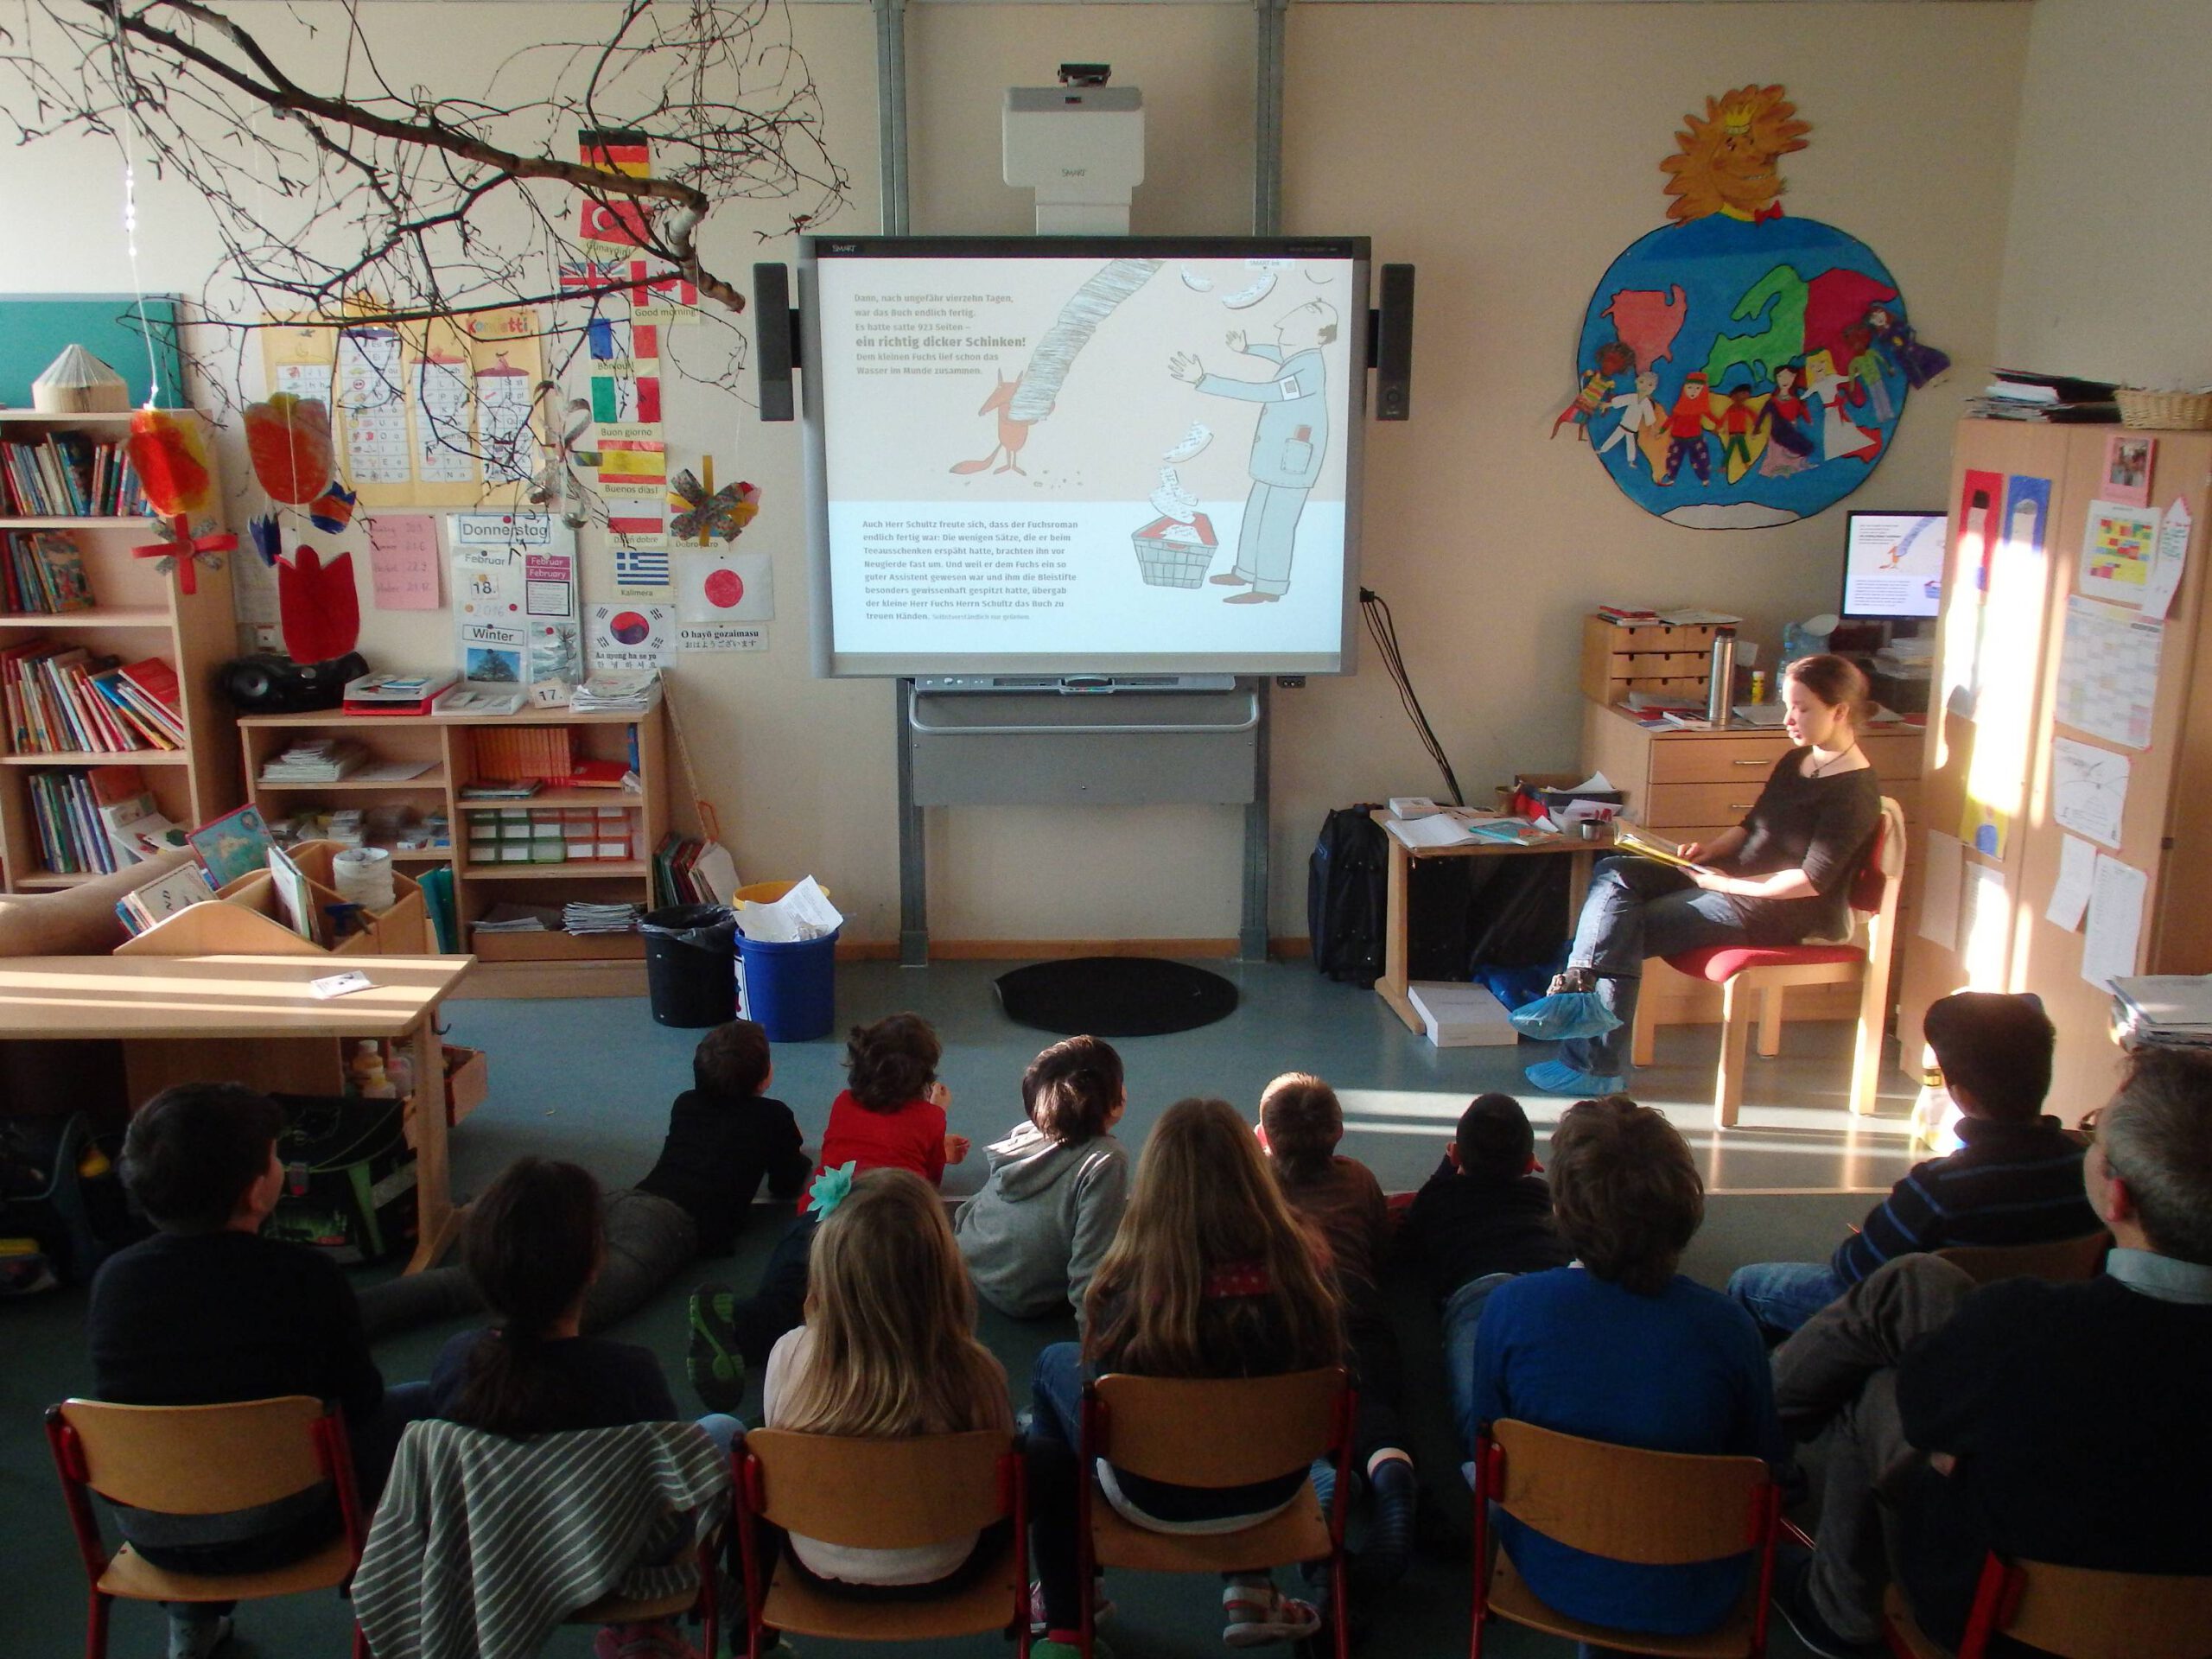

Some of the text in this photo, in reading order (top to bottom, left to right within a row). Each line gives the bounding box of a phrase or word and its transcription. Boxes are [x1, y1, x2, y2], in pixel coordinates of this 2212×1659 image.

[832, 244, 857, 252] SMART
[855, 294, 1014, 303] Dann, nach ungefähr vierzehn Tagen,
[660, 308, 699, 318] morning!
[873, 308, 889, 317] das
[891, 308, 912, 317] Buch
[914, 308, 946, 317] endlich
[949, 308, 976, 318] fertig.
[855, 336, 1026, 349] ein richtig dicker Schinken!
[877, 353, 910, 361] kleinen
[912, 353, 937, 361] Fuchs
[938, 353, 954, 361] lief
[955, 353, 981, 361] schon
[983, 353, 999, 361] das
[890, 366, 901, 375] im
[903, 366, 932, 375] Munde
[625, 429, 652, 437] giorno
[605, 485, 636, 493] Buenos
[462, 524, 548, 538] Donnerstag
[896, 534, 920, 543] fertig
[957, 534, 994, 543] wenigen
[995, 534, 1020, 543] Sätze,
[934, 547, 967, 556] erspäht
[969, 547, 994, 556] hatte,
[465, 554, 505, 566] Februar
[531, 557, 563, 566] Februar
[864, 561, 907, 569] Neugierde
[530, 569, 566, 579] February
[864, 574, 887, 582] guter
[474, 582, 496, 594] 18.
[911, 587, 967, 596] gewissenhaft
[969, 587, 1003, 596] gespitzt
[1005, 587, 1030, 595] hatte,
[1032, 587, 1067, 596] übergab
[881, 599, 907, 607] kleine
[896, 612, 931, 620] Händen.
[473, 628, 514, 642] Winter
[715, 630, 759, 642] gozaimasu
[685, 640, 757, 649] おはようございます
[537, 688, 563, 703] 17.
